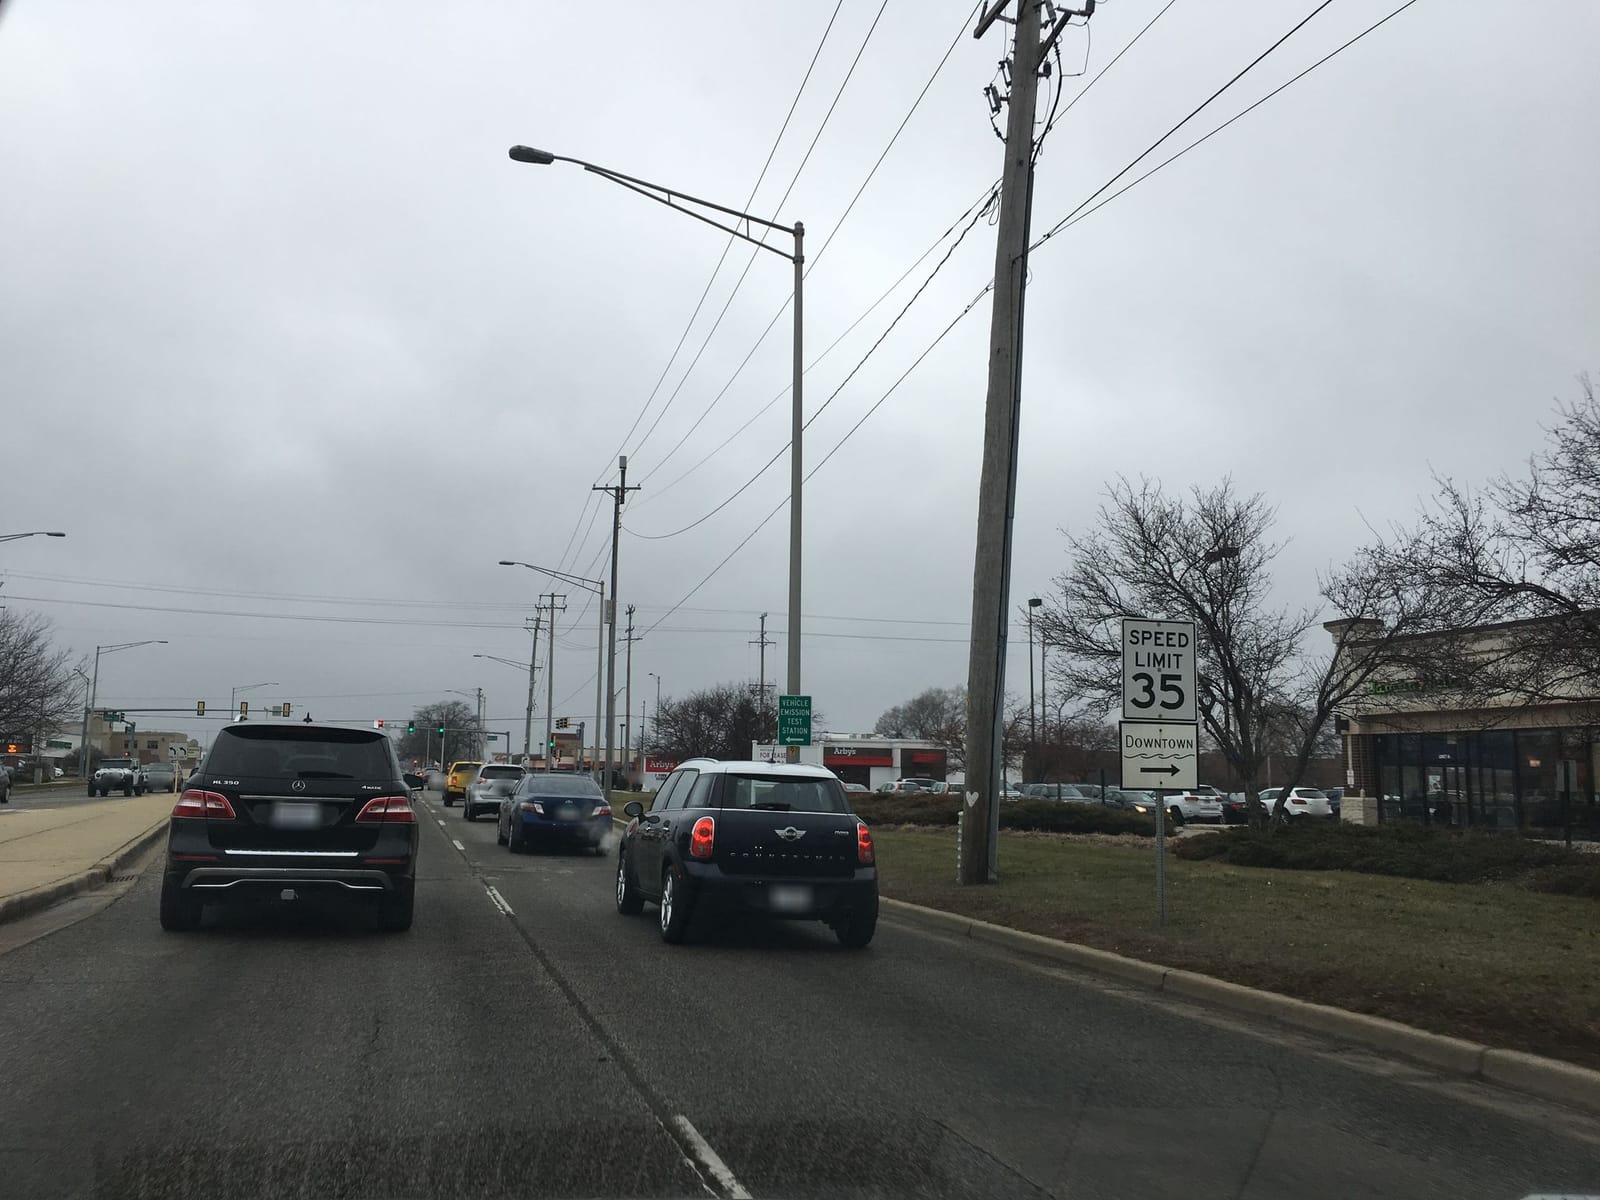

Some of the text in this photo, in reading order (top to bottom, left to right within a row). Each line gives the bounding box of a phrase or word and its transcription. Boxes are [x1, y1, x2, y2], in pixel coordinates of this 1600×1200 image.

[1129, 629, 1189, 648] SPEED
[1135, 651, 1183, 669] LIMIT
[1130, 672, 1185, 710] 35
[782, 699, 809, 707] VEHICLE
[780, 708, 810, 716] EMISSION
[787, 717, 802, 725] TEST
[782, 727, 808, 735] STATION
[833, 747, 857, 757] Arby's
